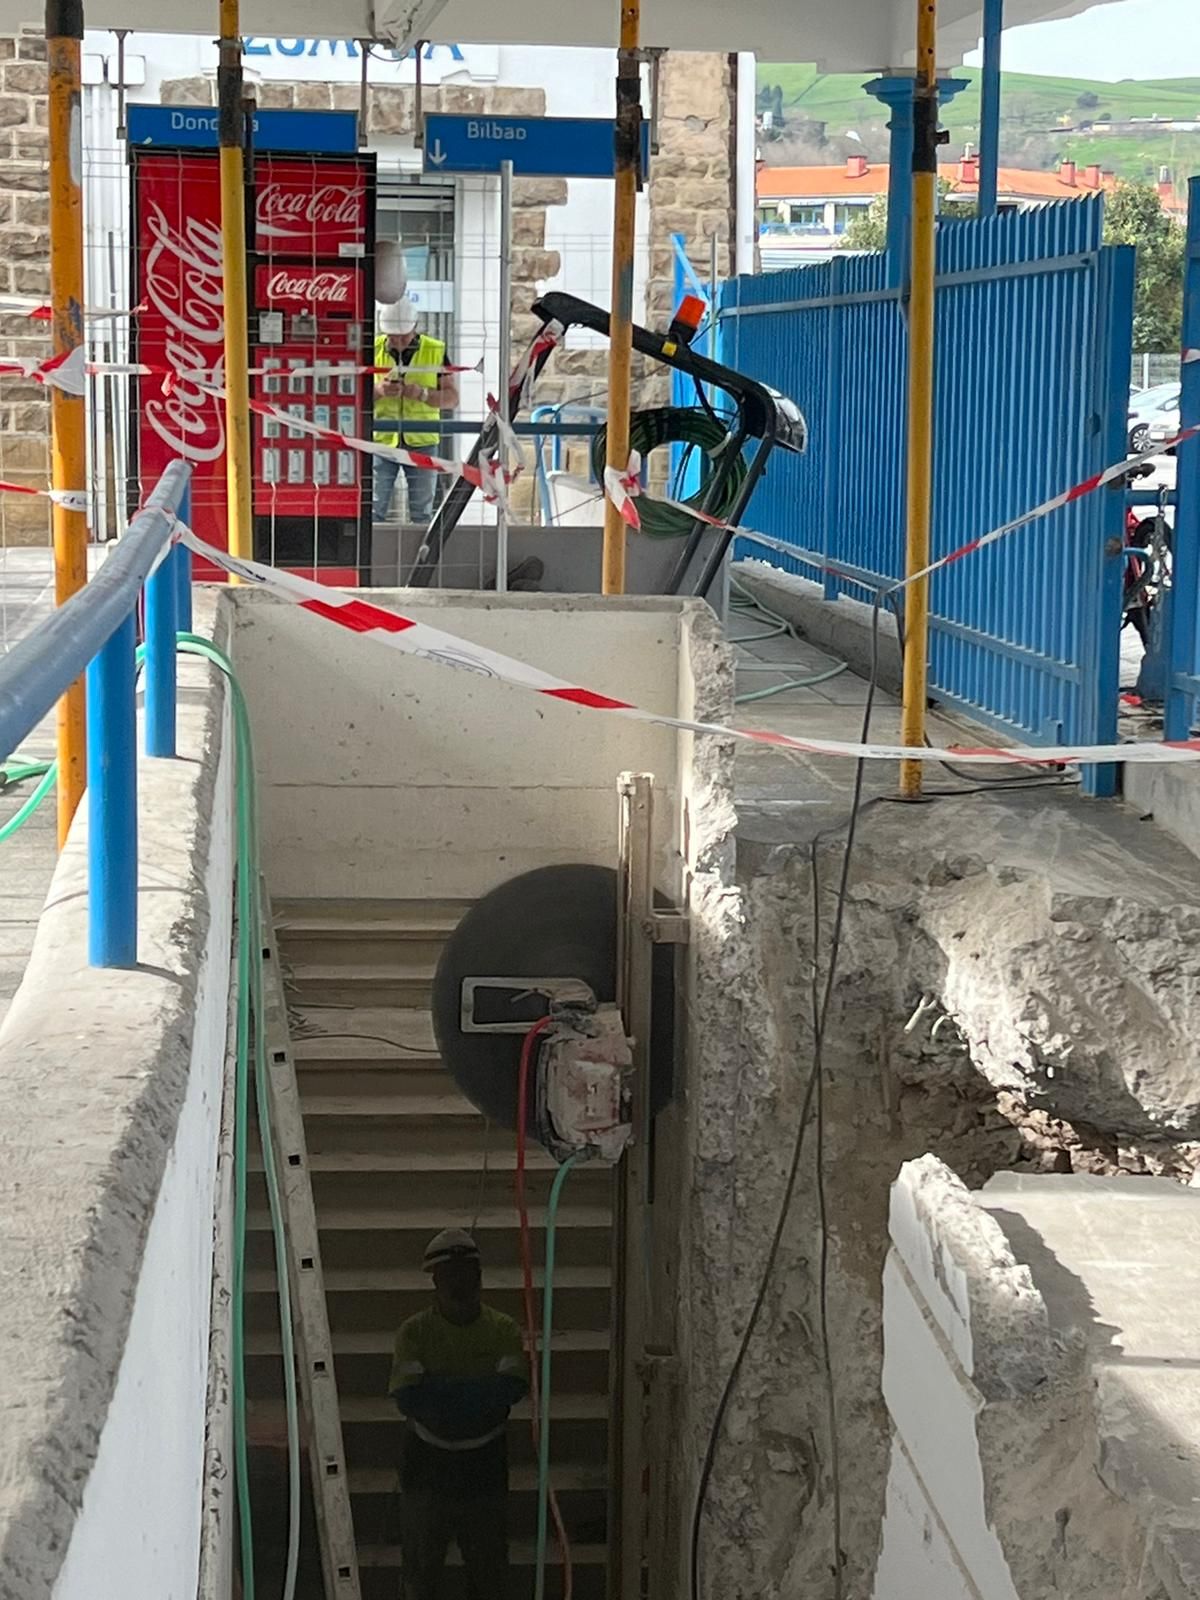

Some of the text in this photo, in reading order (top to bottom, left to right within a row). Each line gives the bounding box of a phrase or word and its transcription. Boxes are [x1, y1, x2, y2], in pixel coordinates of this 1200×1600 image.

[467, 121, 527, 140] Bilbao
[256, 183, 365, 222] Coca-Cola
[266, 271, 353, 301] Coca-Cola
